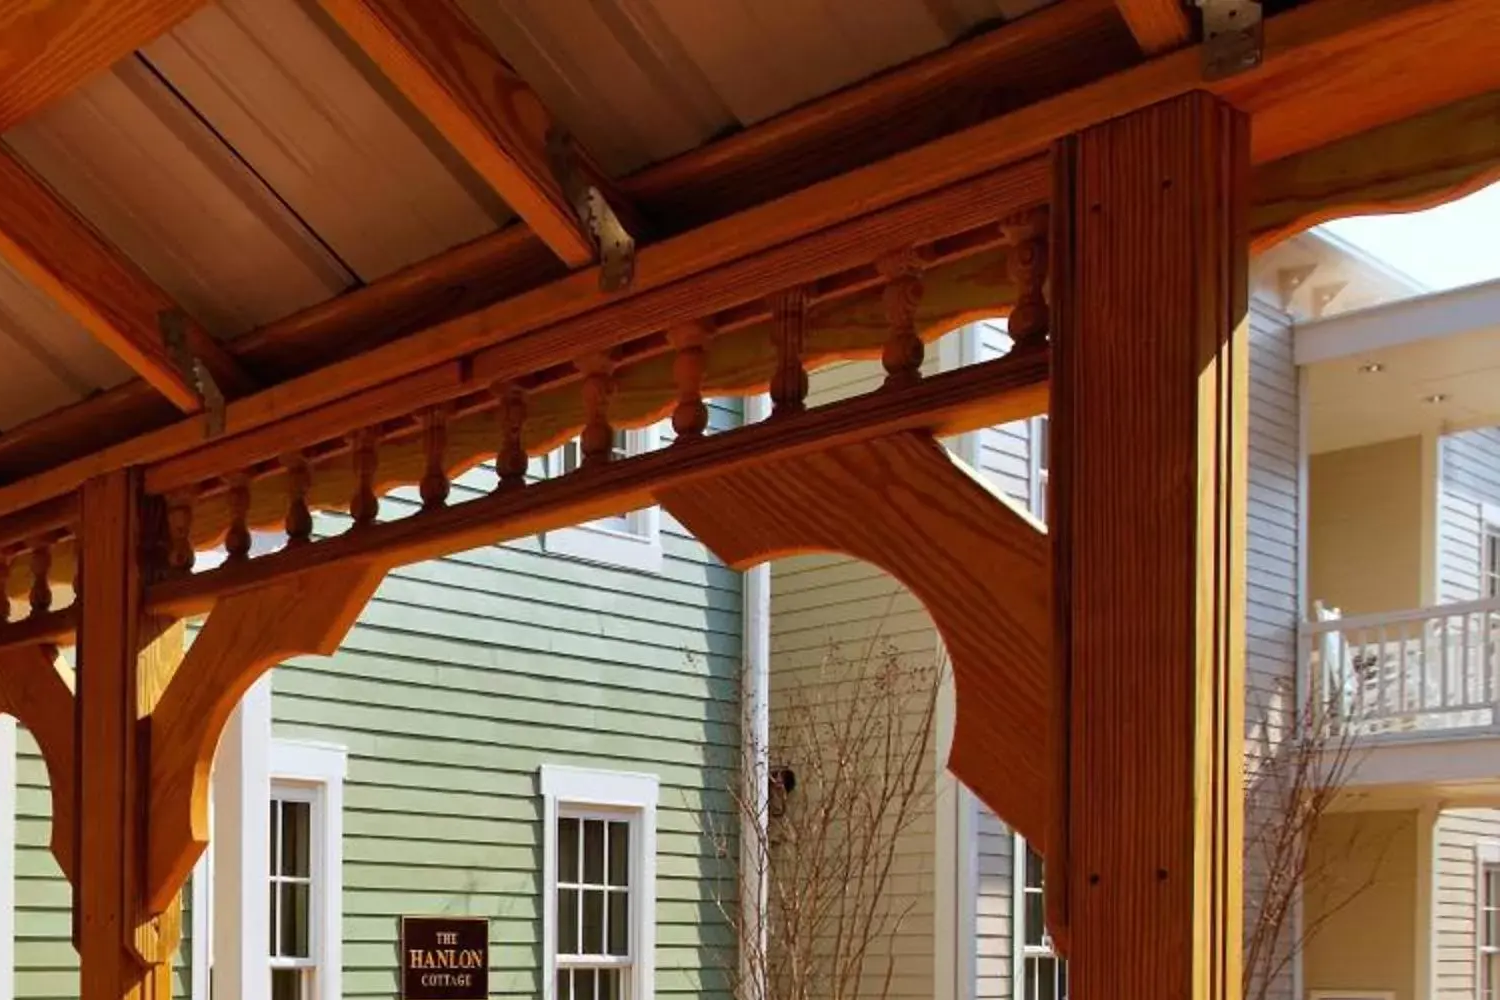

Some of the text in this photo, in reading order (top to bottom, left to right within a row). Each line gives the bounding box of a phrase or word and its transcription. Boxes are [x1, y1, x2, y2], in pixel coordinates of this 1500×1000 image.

[436, 932, 458, 945] THE
[409, 949, 483, 969] HANLON
[421, 973, 472, 987] COTTAGE
